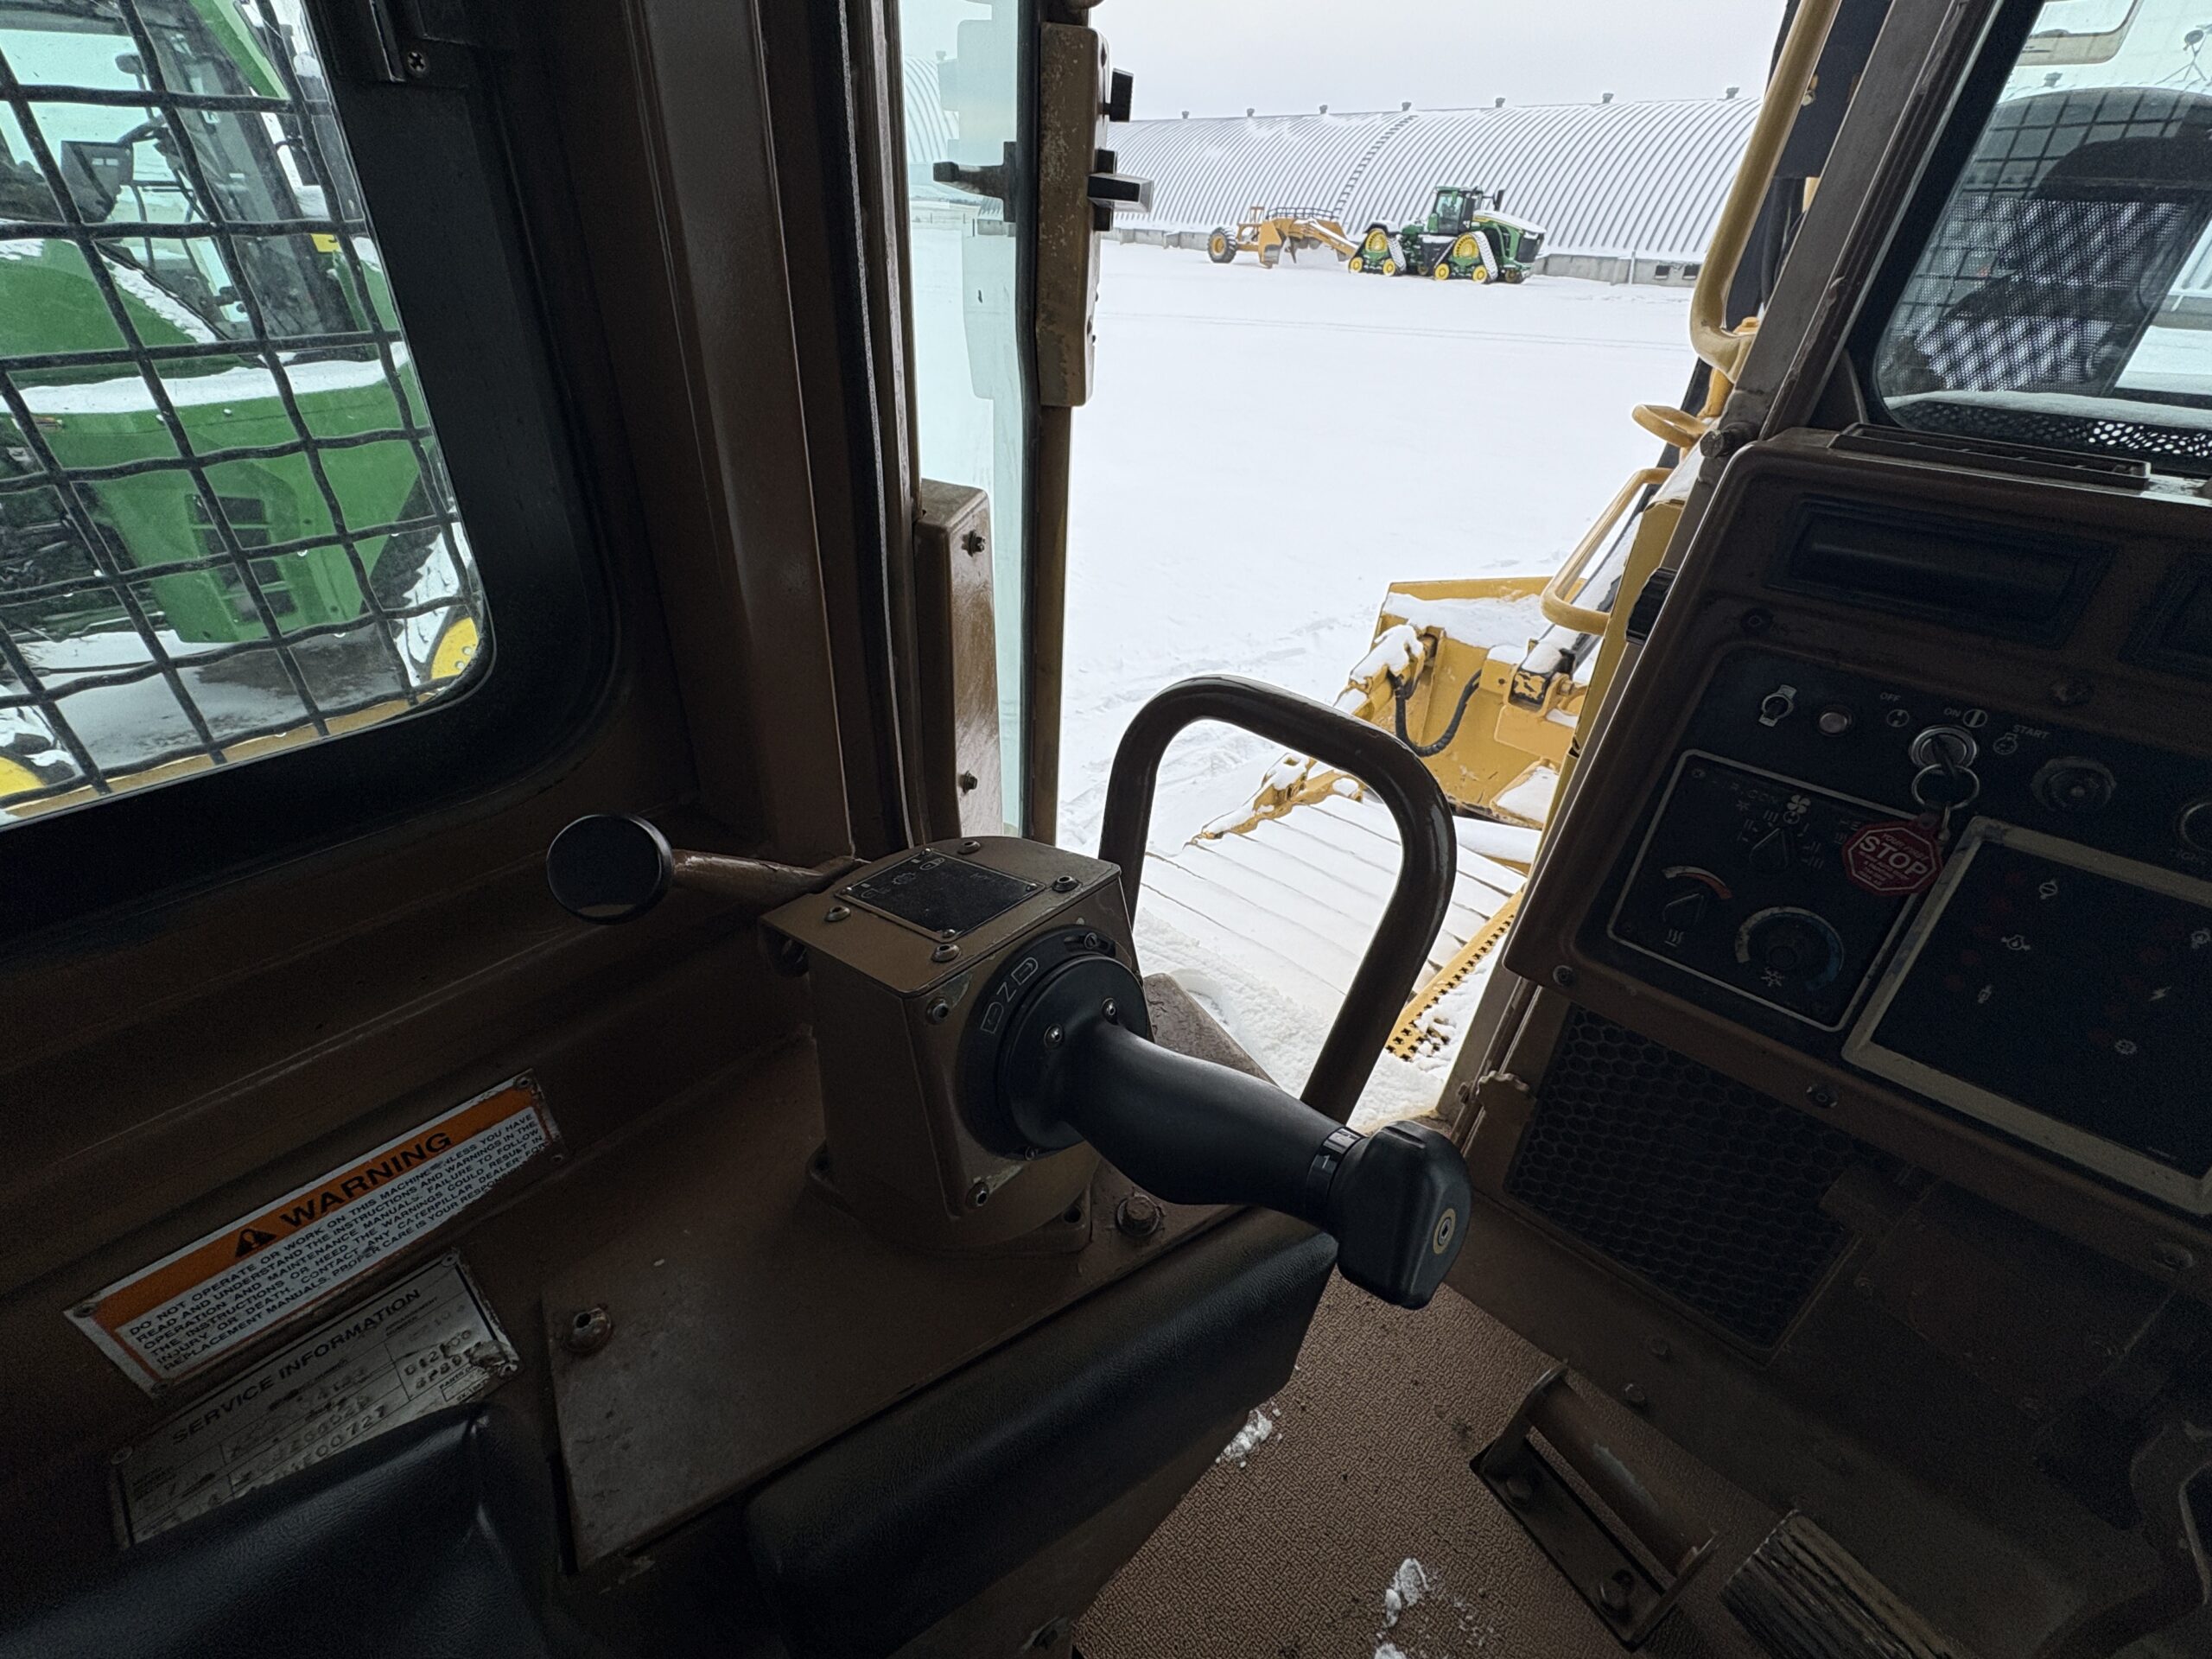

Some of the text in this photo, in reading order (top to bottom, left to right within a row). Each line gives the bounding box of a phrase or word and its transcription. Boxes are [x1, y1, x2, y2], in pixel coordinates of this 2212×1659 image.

[1879, 691, 1902, 703] OFF
[1943, 707, 1962, 719] ON
[2012, 724, 2050, 741] START
[1859, 836, 1929, 876] STOP
[128, 1319, 153, 1335] DO
[156, 1300, 188, 1320] NOT
[190, 1263, 257, 1301] OPERATE
[259, 1250, 280, 1264] OR
[283, 1227, 323, 1251] WORK
[326, 1214, 346, 1228] ON
[349, 1198, 376, 1215] THIS
[436, 1143, 477, 1168] NLESS
[480, 1129, 502, 1145] YOU
[505, 1113, 532, 1131] HAVE
[137, 1121, 537, 1341] READ AND UNDERSTAND THE INSTRUCTIONS AND WARNINGS IN THE
[142, 1300, 227, 1349] OPERATION
[232, 1281, 262, 1300] AND
[266, 1228, 359, 1281] MAINTENANCE
[427, 1165, 474, 1192] FAILURE
[476, 1154, 493, 1166] TO
[495, 1128, 539, 1154] FOLLOW
[149, 1337, 181, 1356] THE
[184, 1279, 285, 1337] INSTRUCTIONS
[289, 1266, 309, 1279] OR
[314, 1243, 349, 1266] HEED
[352, 1228, 378, 1244] THE
[380, 1191, 443, 1228] WARNINGS
[447, 1167, 484, 1191] COULD
[488, 1143, 528, 1167] RESULT
[156, 1332, 210, 1363] INJURY
[215, 1316, 238, 1330] OR
[300, 1248, 360, 1283] CONTACT
[366, 1230, 391, 1246] ANY
[396, 1184, 473, 1229] CATERPILLAR
[477, 1157, 520, 1183] DEALER
[278, 1129, 453, 1230] WARNING
[162, 1312, 264, 1370] REPLACEMENT
[331, 1246, 381, 1276] PROPER
[381, 1227, 413, 1247] CARE
[415, 1219, 426, 1228] IS
[428, 1201, 458, 1221] YOUR
[170, 1373, 275, 1446] SERVICE
[277, 1287, 421, 1382] INFORMATION
